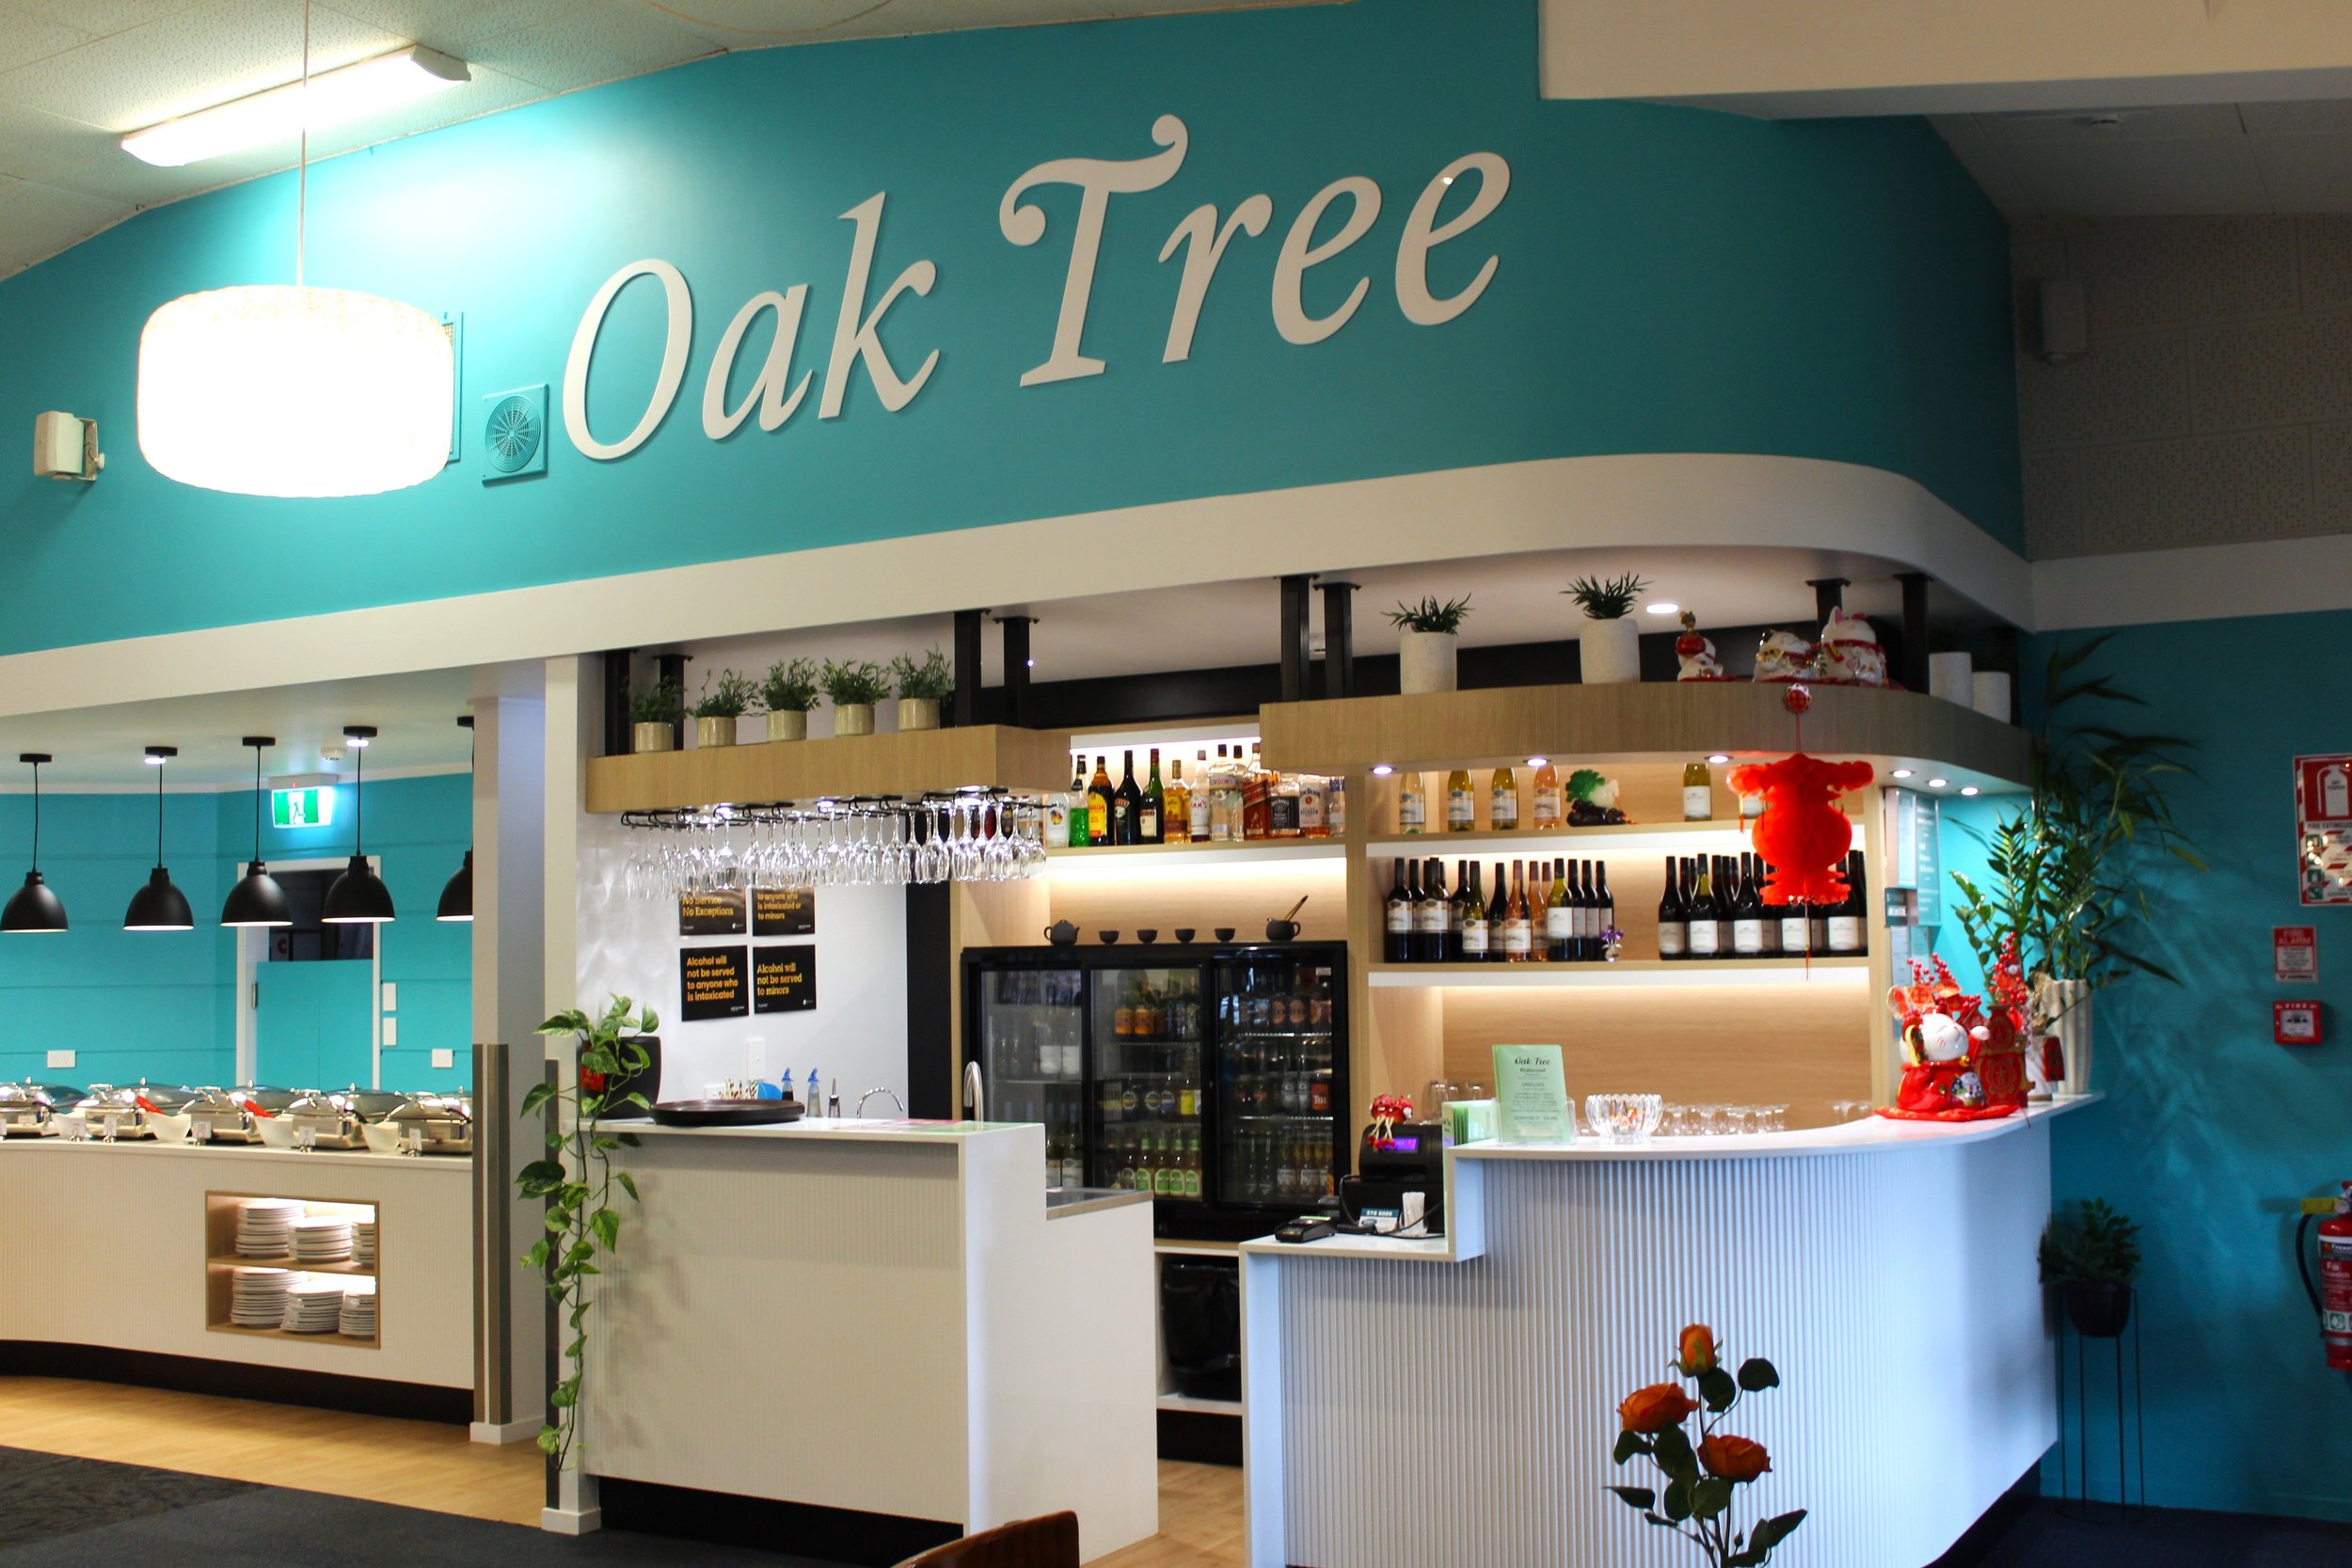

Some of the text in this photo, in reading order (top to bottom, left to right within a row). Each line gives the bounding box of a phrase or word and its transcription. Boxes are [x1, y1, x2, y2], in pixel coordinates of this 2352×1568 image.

[564, 115, 1510, 460] Oak Tree
[757, 893, 764, 901] to
[764, 894, 787, 903] anyone
[682, 906, 734, 918] No Exceptions
[757, 902, 763, 911] is
[763, 901, 795, 911] intoxicated
[757, 911, 786, 921] to minors
[687, 955, 727, 967] Alcohol will
[687, 966, 735, 978] not be served
[756, 962, 796, 974] Alcohol will
[687, 978, 739, 991] to anyone who
[756, 974, 803, 986] not be served
[687, 990, 735, 1003] is intoxicated
[757, 986, 789, 997] to minors
[1514, 1056, 1531, 1066] Oak
